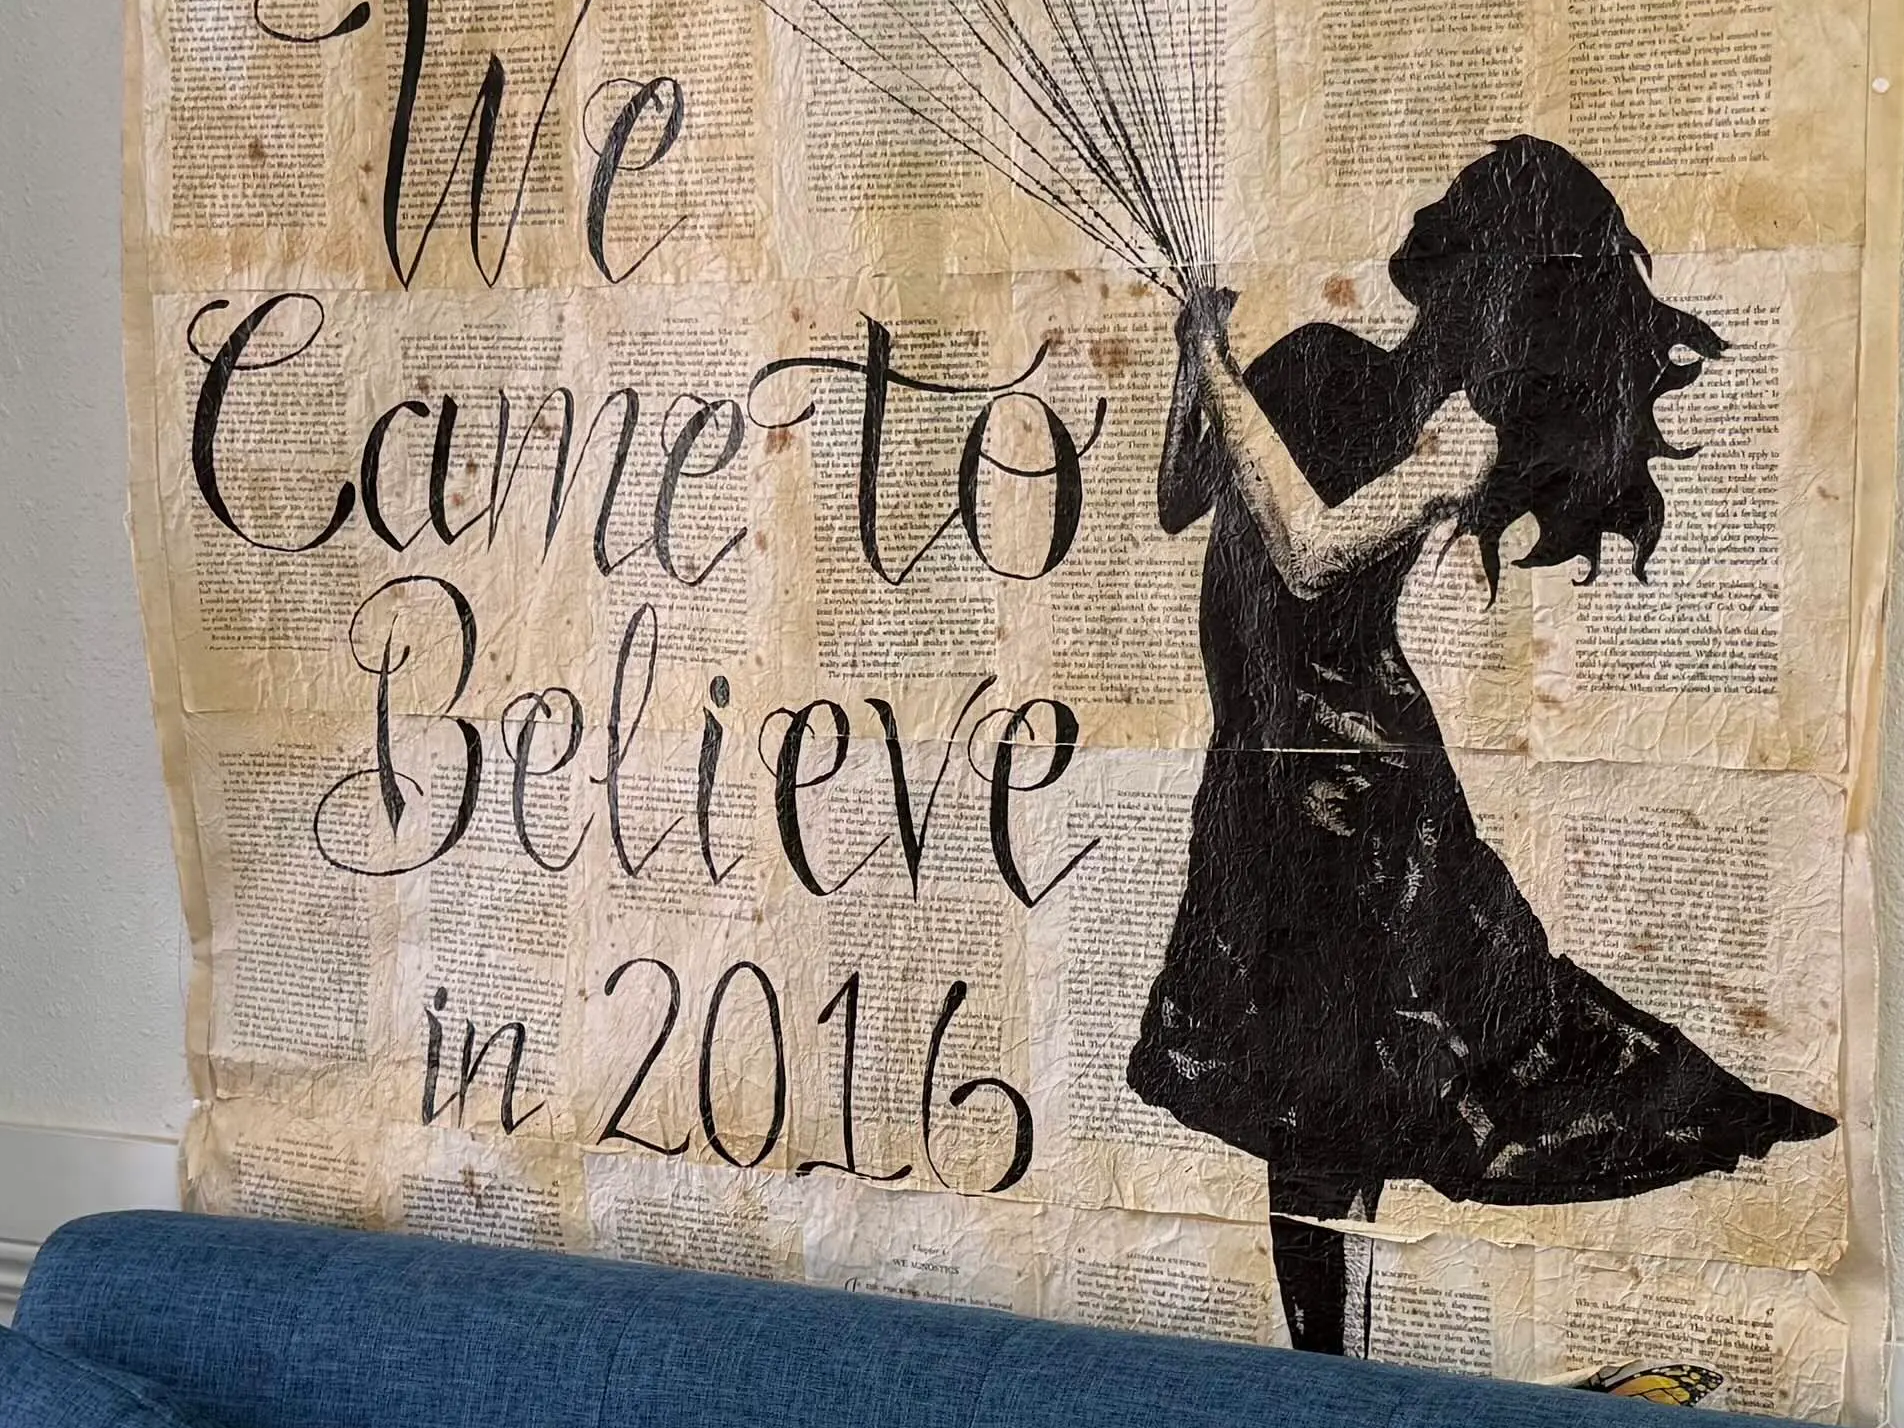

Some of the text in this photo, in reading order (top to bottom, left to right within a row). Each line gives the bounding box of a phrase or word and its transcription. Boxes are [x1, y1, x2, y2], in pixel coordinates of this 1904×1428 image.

[1754, 305, 1766, 315] the
[185, 290, 750, 588] Came
[748, 309, 1107, 586] to
[1761, 474, 1779, 482] with
[312, 573, 1101, 910] Believe
[419, 985, 549, 1134] in
[594, 955, 1036, 1196] 2016
[893, 1258, 960, 1275] WE AGNOSTICS
[1765, 1331, 1774, 1341] to
